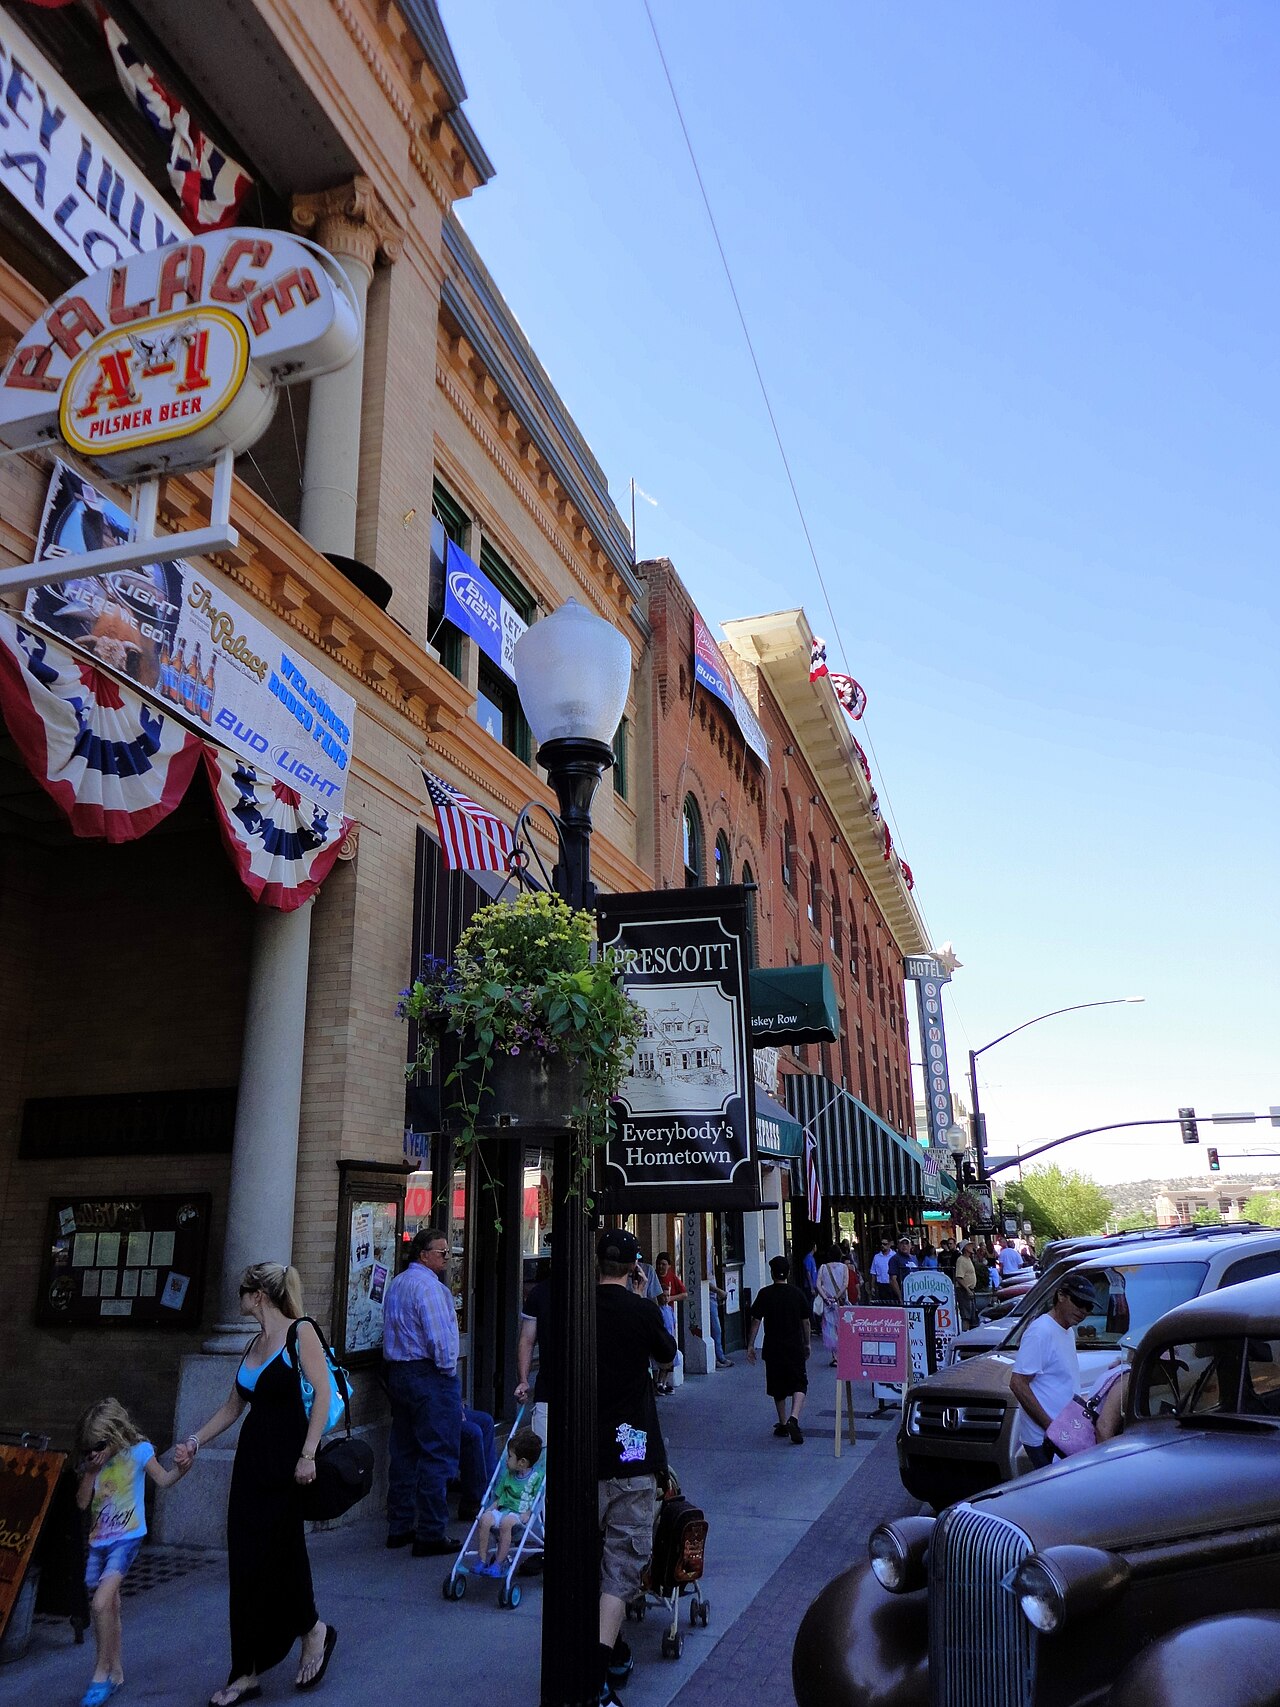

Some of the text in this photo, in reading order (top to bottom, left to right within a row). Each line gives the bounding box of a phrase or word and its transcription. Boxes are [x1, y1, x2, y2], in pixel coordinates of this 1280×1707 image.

[5, 238, 320, 393] PALACE
[75, 330, 212, 419] A-1
[89, 396, 203, 440] PILSNER BEER
[113, 576, 180, 616] LIGHT
[456, 586, 500, 632] LIGHT
[466, 581, 497, 621] BUD
[188, 581, 218, 622] The
[211, 611, 268, 682] Palace
[696, 664, 716, 685] BUD
[281, 652, 350, 745] WELCOMES
[268, 670, 348, 770] RODEO FANS
[214, 707, 340, 798] BUD LIGHT
[613, 943, 731, 975] PRESCOTT
[909, 960, 944, 978] HOTEL
[777, 1014, 798, 1025] Row
[929, 1029, 949, 1144] MICHAEL
[621, 1121, 734, 1146] Everybody's
[625, 1147, 732, 1166] Hometown
[906, 1276, 950, 1296] Hooligan's
